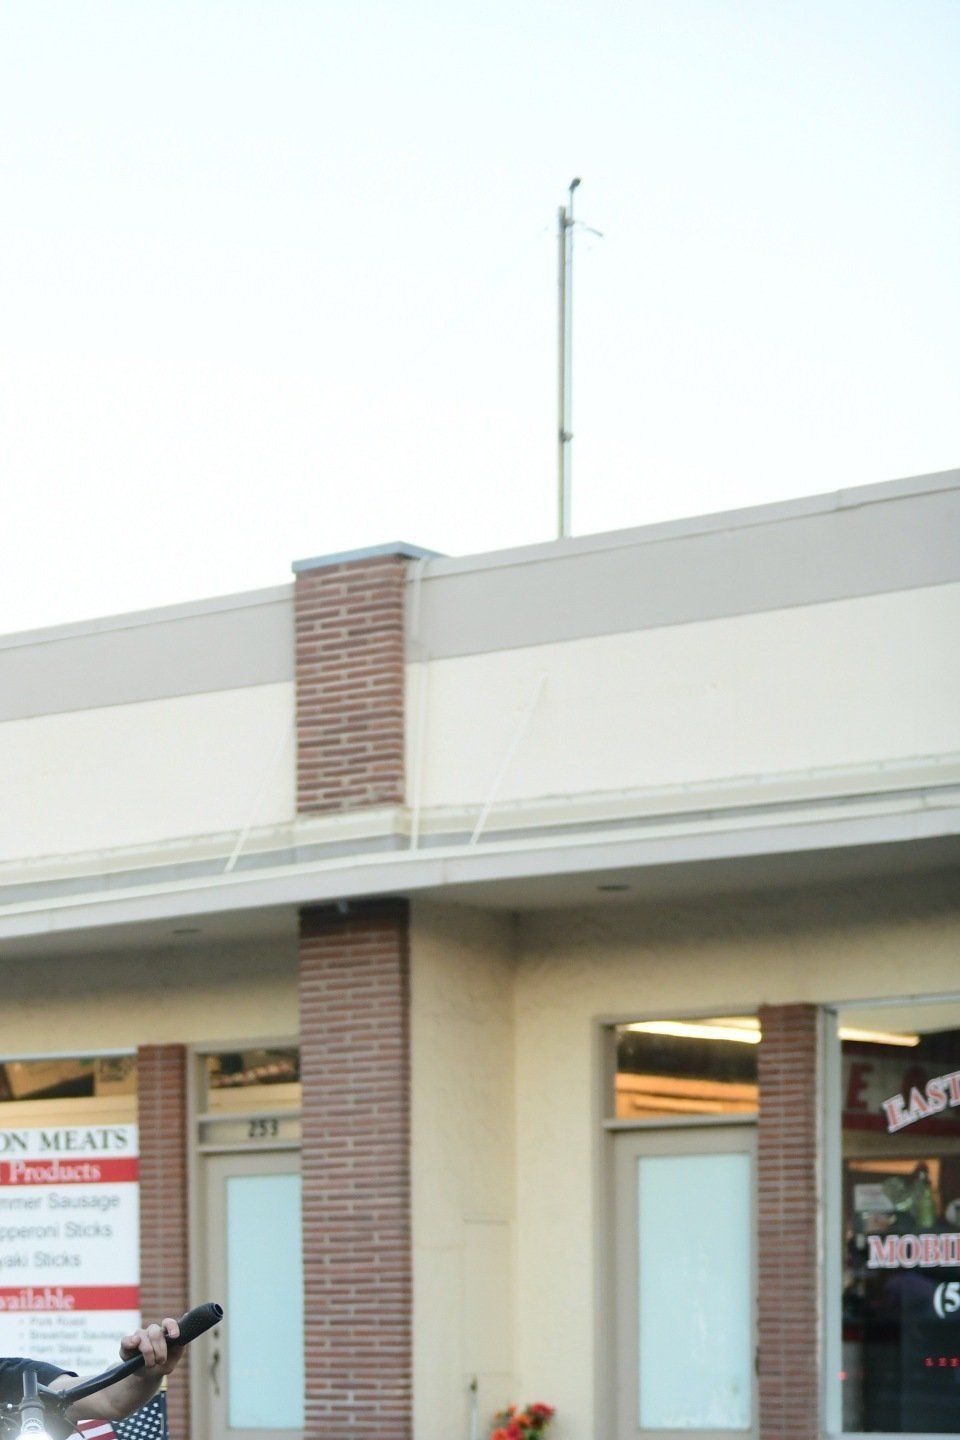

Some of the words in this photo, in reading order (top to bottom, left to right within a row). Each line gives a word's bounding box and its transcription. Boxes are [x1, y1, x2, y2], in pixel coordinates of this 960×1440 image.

[40, 1128, 128, 1151] MEATS
[9, 1159, 101, 1183] Products
[48, 1193, 120, 1211] Sausage
[65, 1221, 113, 1238] Sticks
[34, 1251, 81, 1268] Sticks
